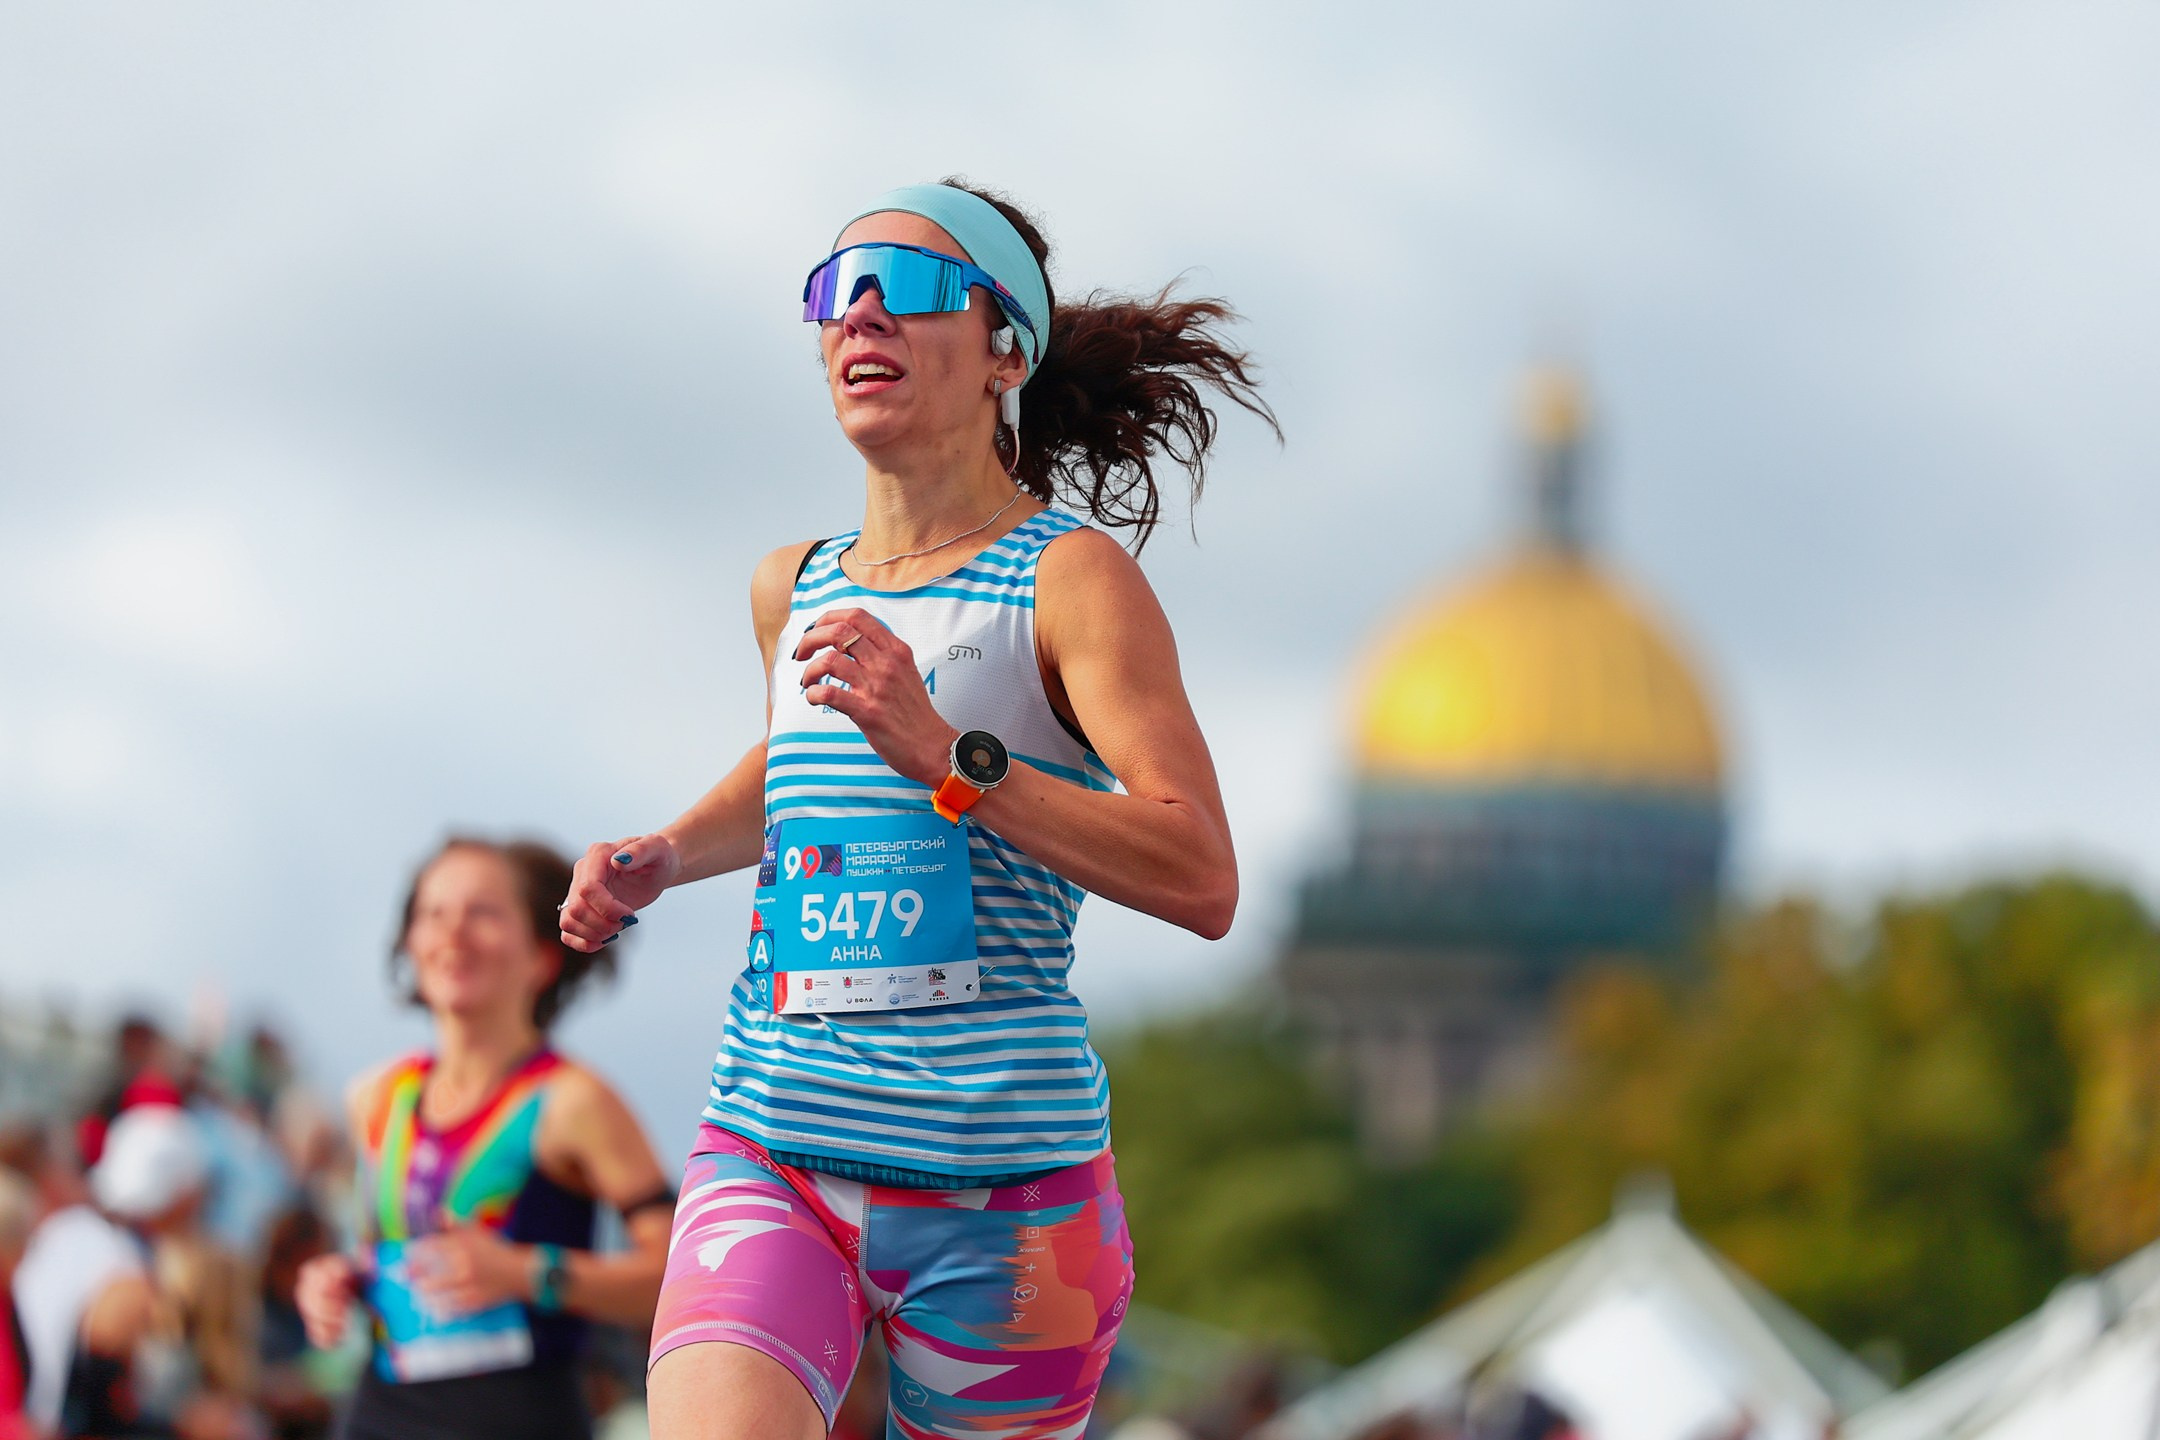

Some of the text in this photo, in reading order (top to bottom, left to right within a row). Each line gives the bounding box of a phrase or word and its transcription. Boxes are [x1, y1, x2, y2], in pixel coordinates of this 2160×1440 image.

[845, 835, 946, 854] ПЕТЕРБУРГСКИЙ
[784, 846, 822, 880] 99
[845, 853, 906, 867] МАРАФОН
[846, 863, 947, 877] ПУШКИН ПЕТЕРБУРГ
[800, 888, 924, 942] 5479
[830, 944, 883, 962] АННА
